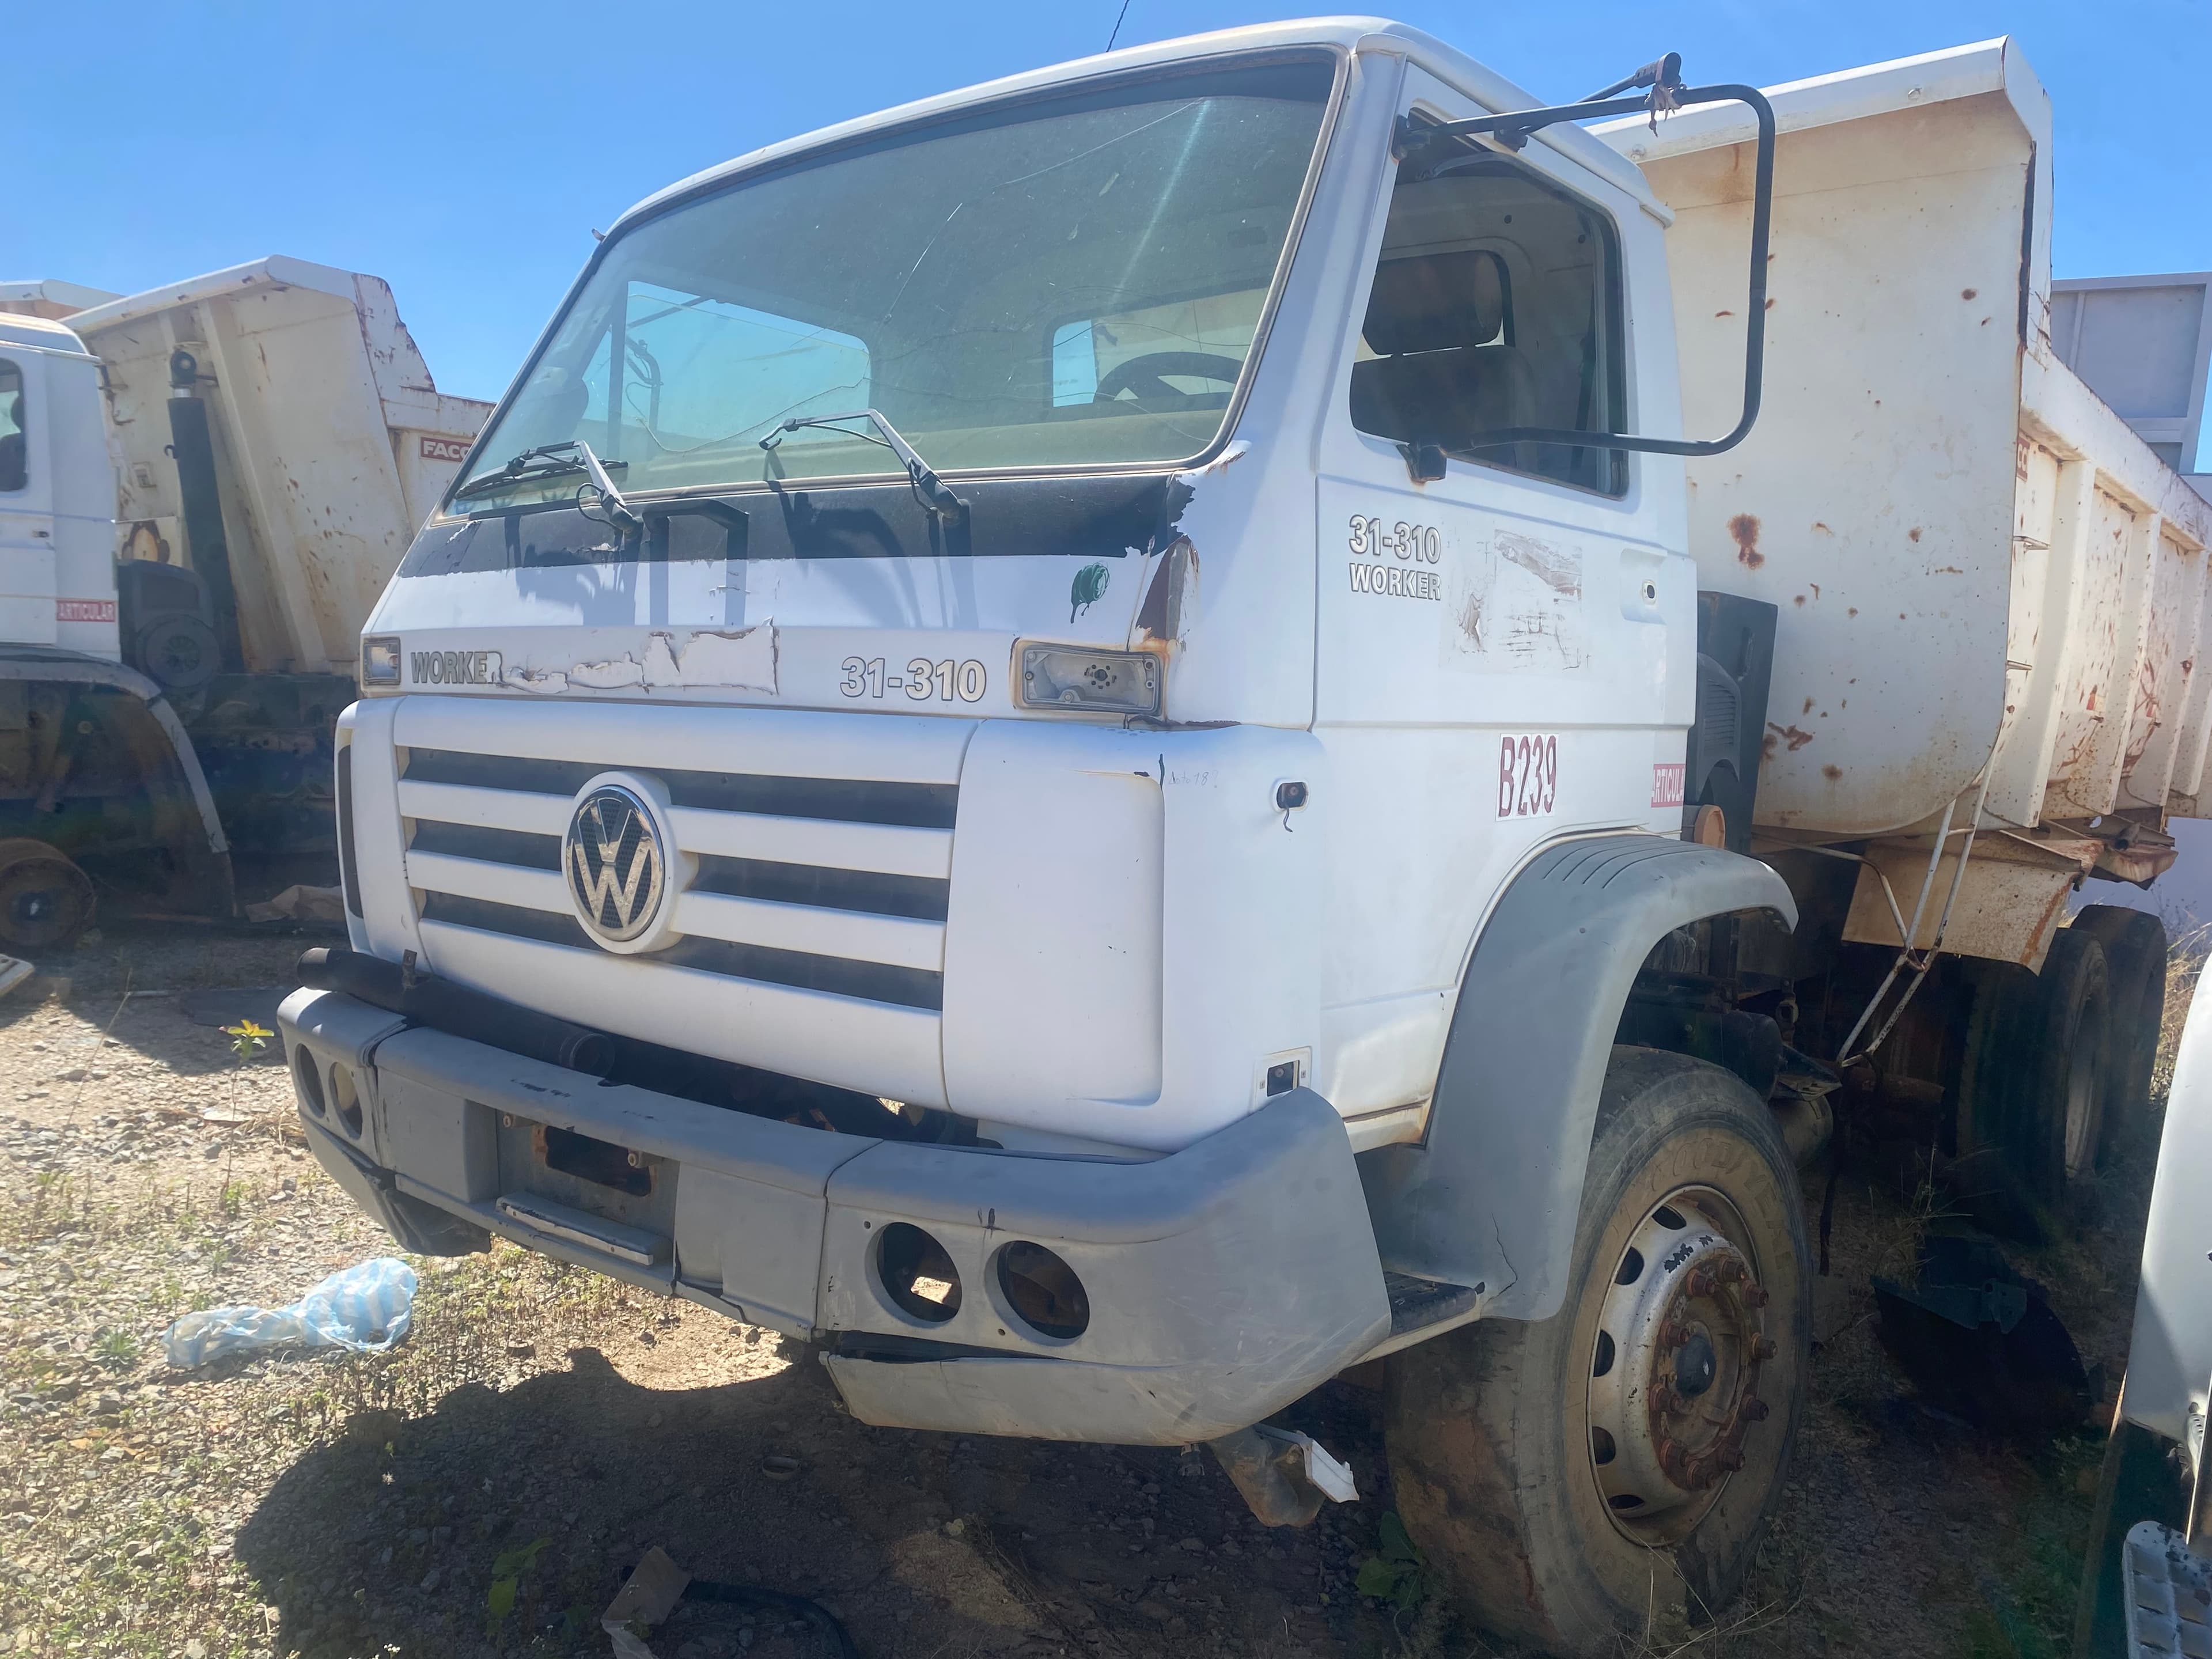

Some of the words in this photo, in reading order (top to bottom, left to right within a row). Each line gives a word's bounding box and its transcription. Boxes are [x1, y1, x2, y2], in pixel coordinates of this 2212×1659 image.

[1349, 514, 1441, 564] 31-310
[1349, 563, 1441, 601] WORKER
[410, 651, 503, 684] WORKER
[840, 656, 986, 702] 31-310
[1498, 735, 1556, 817] B239
